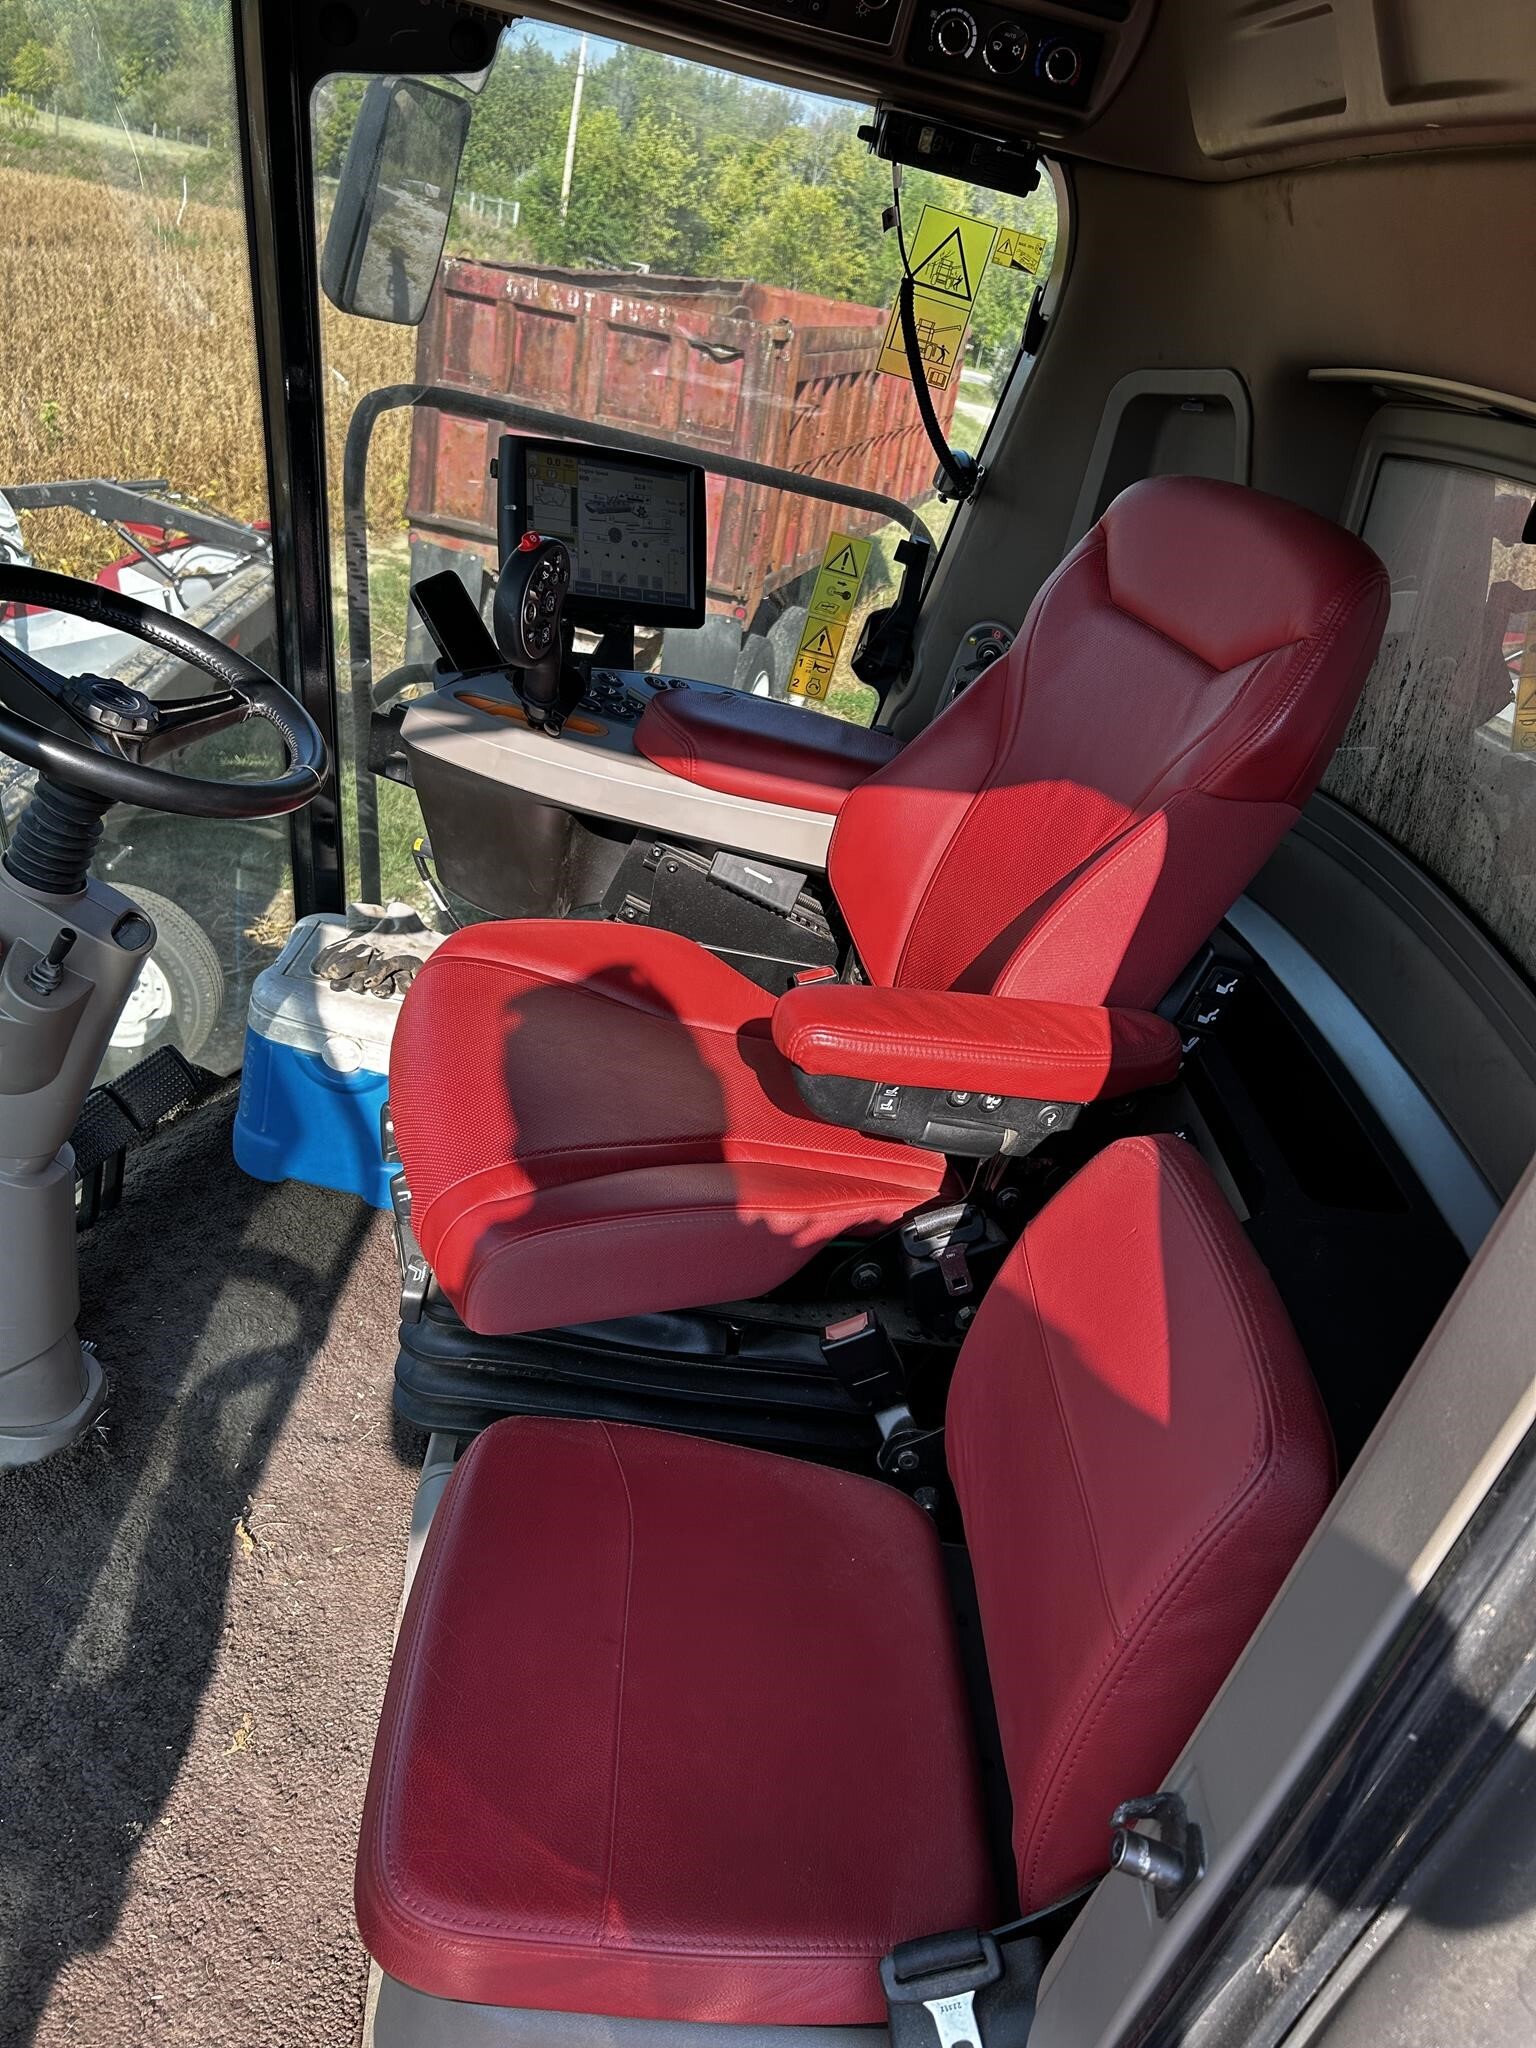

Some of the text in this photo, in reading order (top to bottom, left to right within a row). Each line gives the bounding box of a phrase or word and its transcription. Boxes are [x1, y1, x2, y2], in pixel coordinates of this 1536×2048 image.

[547, 456, 561, 467] 0.0
[798, 658, 804, 668] 1
[792, 678, 800, 687] 2
